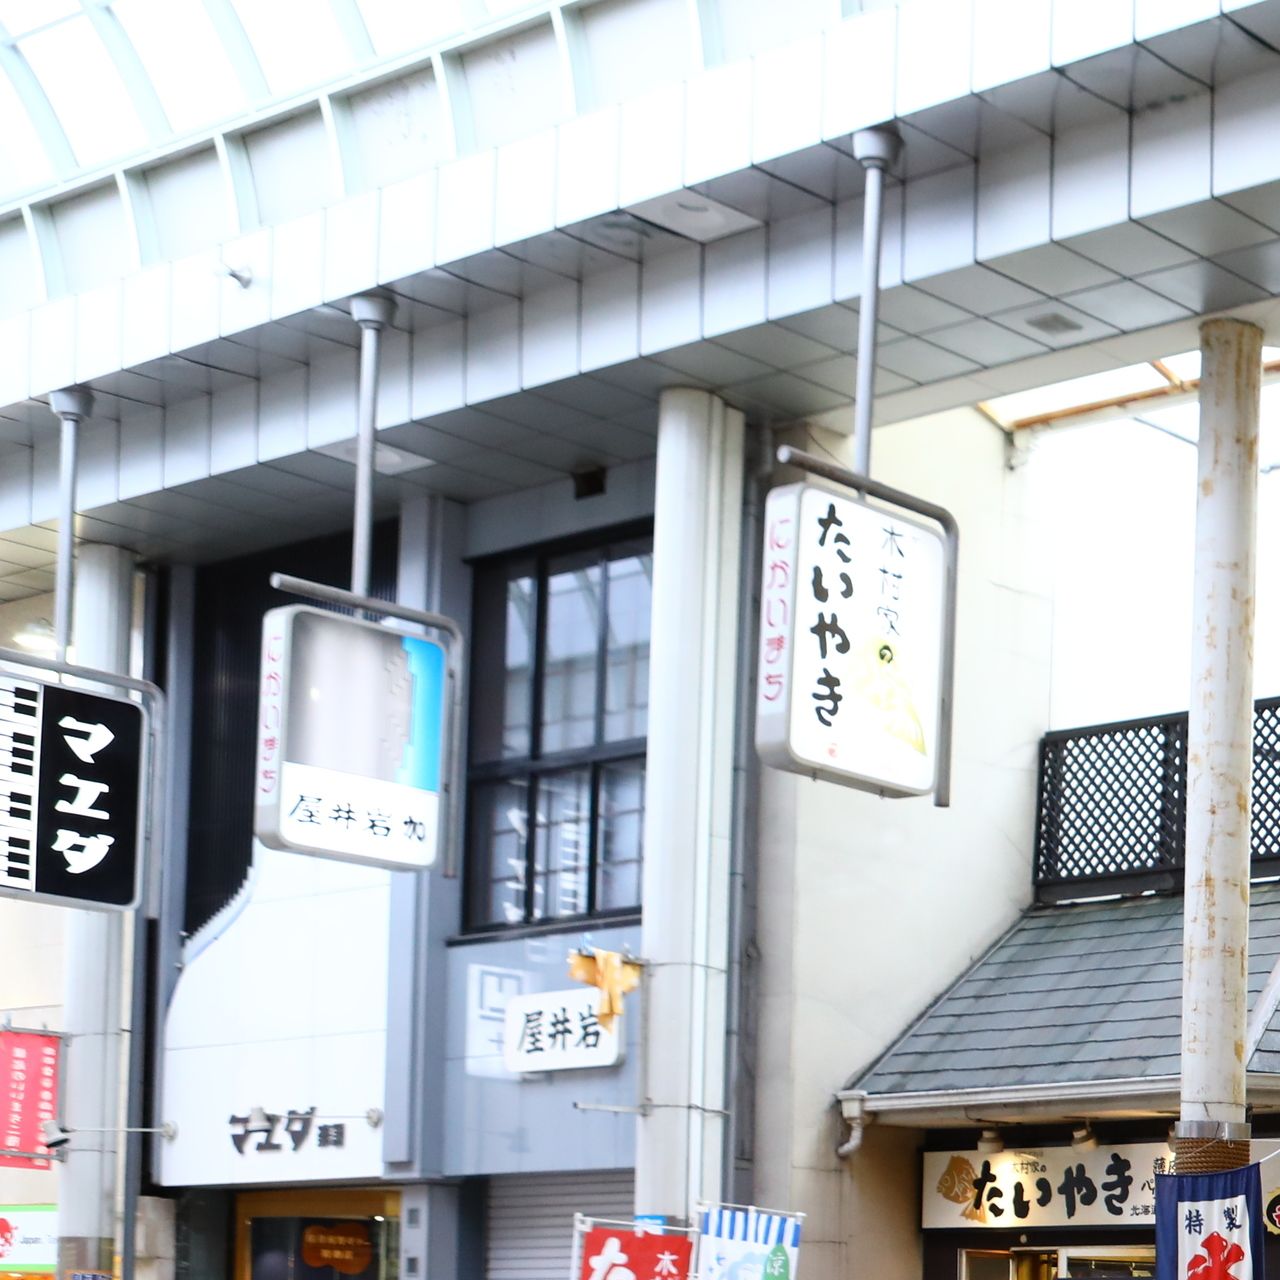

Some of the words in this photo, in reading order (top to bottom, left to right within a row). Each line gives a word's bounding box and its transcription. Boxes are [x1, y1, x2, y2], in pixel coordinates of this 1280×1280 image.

[810, 502, 853, 727] たいやき
[51, 715, 116, 874] マエダ
[972, 1152, 1133, 1221] たいやき
[1184, 1204, 1242, 1236] 特製
